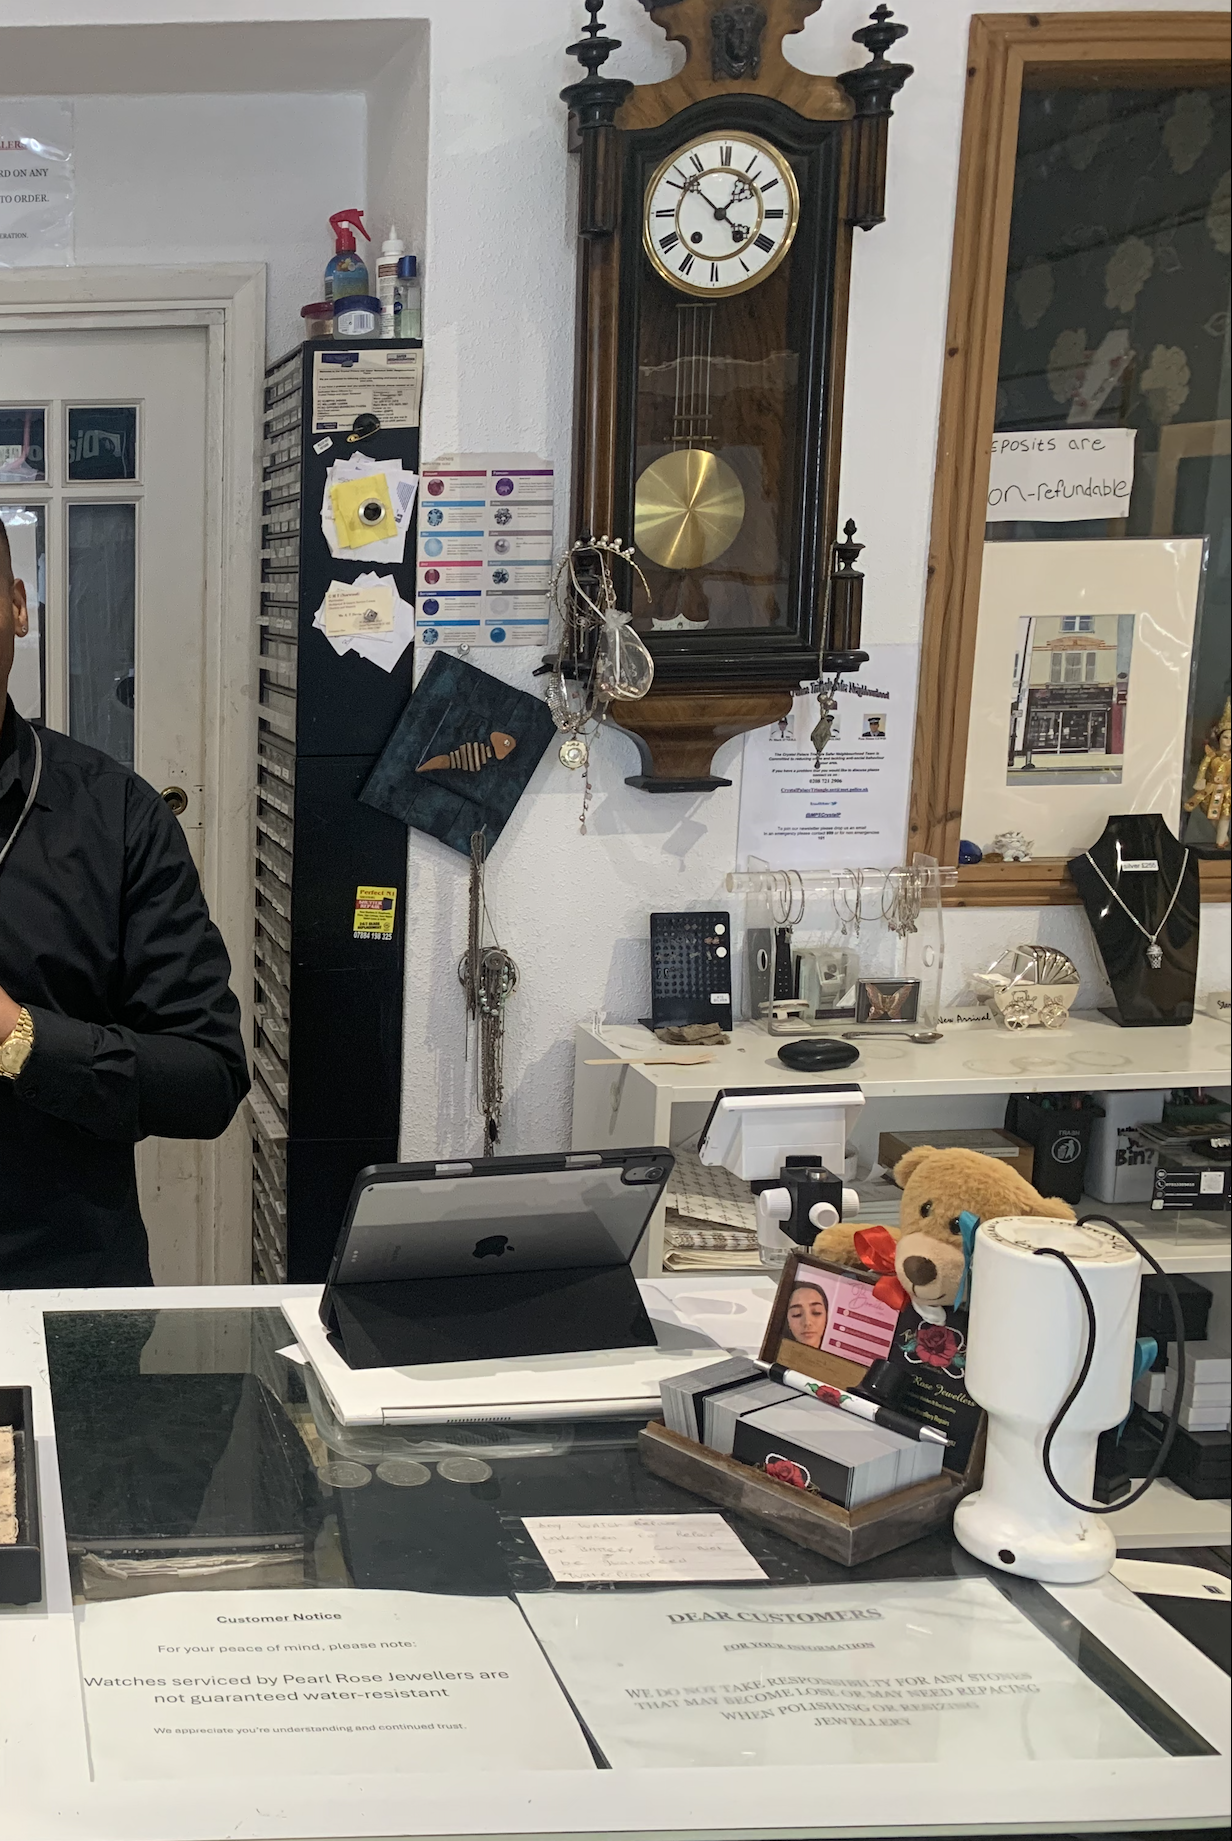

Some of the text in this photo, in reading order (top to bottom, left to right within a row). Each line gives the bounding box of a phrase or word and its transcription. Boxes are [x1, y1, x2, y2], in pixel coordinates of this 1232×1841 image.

[12, 169, 27, 177] ON
[29, 168, 48, 177] ANY
[13, 193, 49, 203] ORDER.
[1069, 437, 1106, 451] are
[988, 477, 1129, 506] on-refundable
[937, 1012, 992, 1024] New Arrival
[1058, 1129, 1082, 1137] TRASH
[1116, 1148, 1154, 1166] Bin?
[293, 1612, 341, 1621] Notice
[666, 1608, 881, 1624] DEAR CUSTOMERS
[158, 1645, 180, 1653] For
[183, 1646, 214, 1654] your
[266, 1644, 280, 1652] of
[284, 1643, 325, 1651] mind,
[328, 1642, 376, 1651] please
[83, 1670, 509, 1691] Watches serviced by Pearl Rose Jewellers are
[625, 1672, 1033, 1698] WE DO NOT TAKE RESPONSIBILTY FOR ANY STONES
[154, 1688, 449, 1705] not guaranteed water-resistant
[634, 1684, 1041, 1710] THAT MAY BECOME LOSE OR MAY NEED REPACING
[719, 1701, 980, 1720] WHEN POLISHING OR RESIZING
[814, 1717, 912, 1726] JEWELLERY
[272, 1725, 353, 1733] understanding
